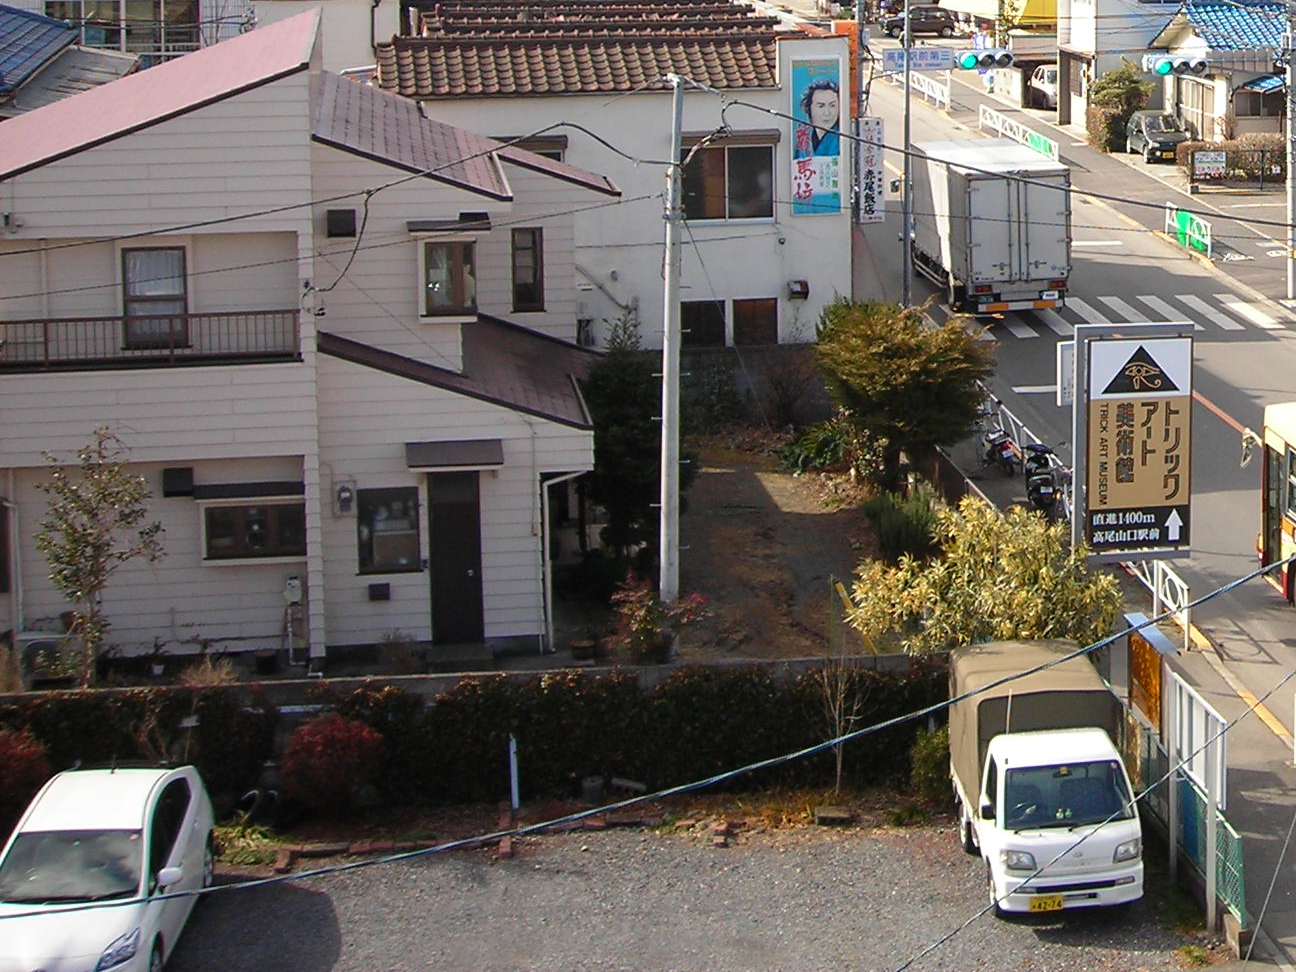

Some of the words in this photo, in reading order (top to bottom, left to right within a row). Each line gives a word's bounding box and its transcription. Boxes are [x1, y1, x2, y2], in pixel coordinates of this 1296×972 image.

[1099, 402, 1109, 433] TRICK
[1141, 401, 1159, 467] アート
[1099, 437, 1109, 459] ART
[1115, 402, 1135, 484] 美術館
[1163, 401, 1181, 501] トリック
[1098, 461, 1108, 505] MUSEUM
[1092, 511, 1156, 526] 直進1400m
[1092, 529, 1160, 544] 高尾山口駅前
